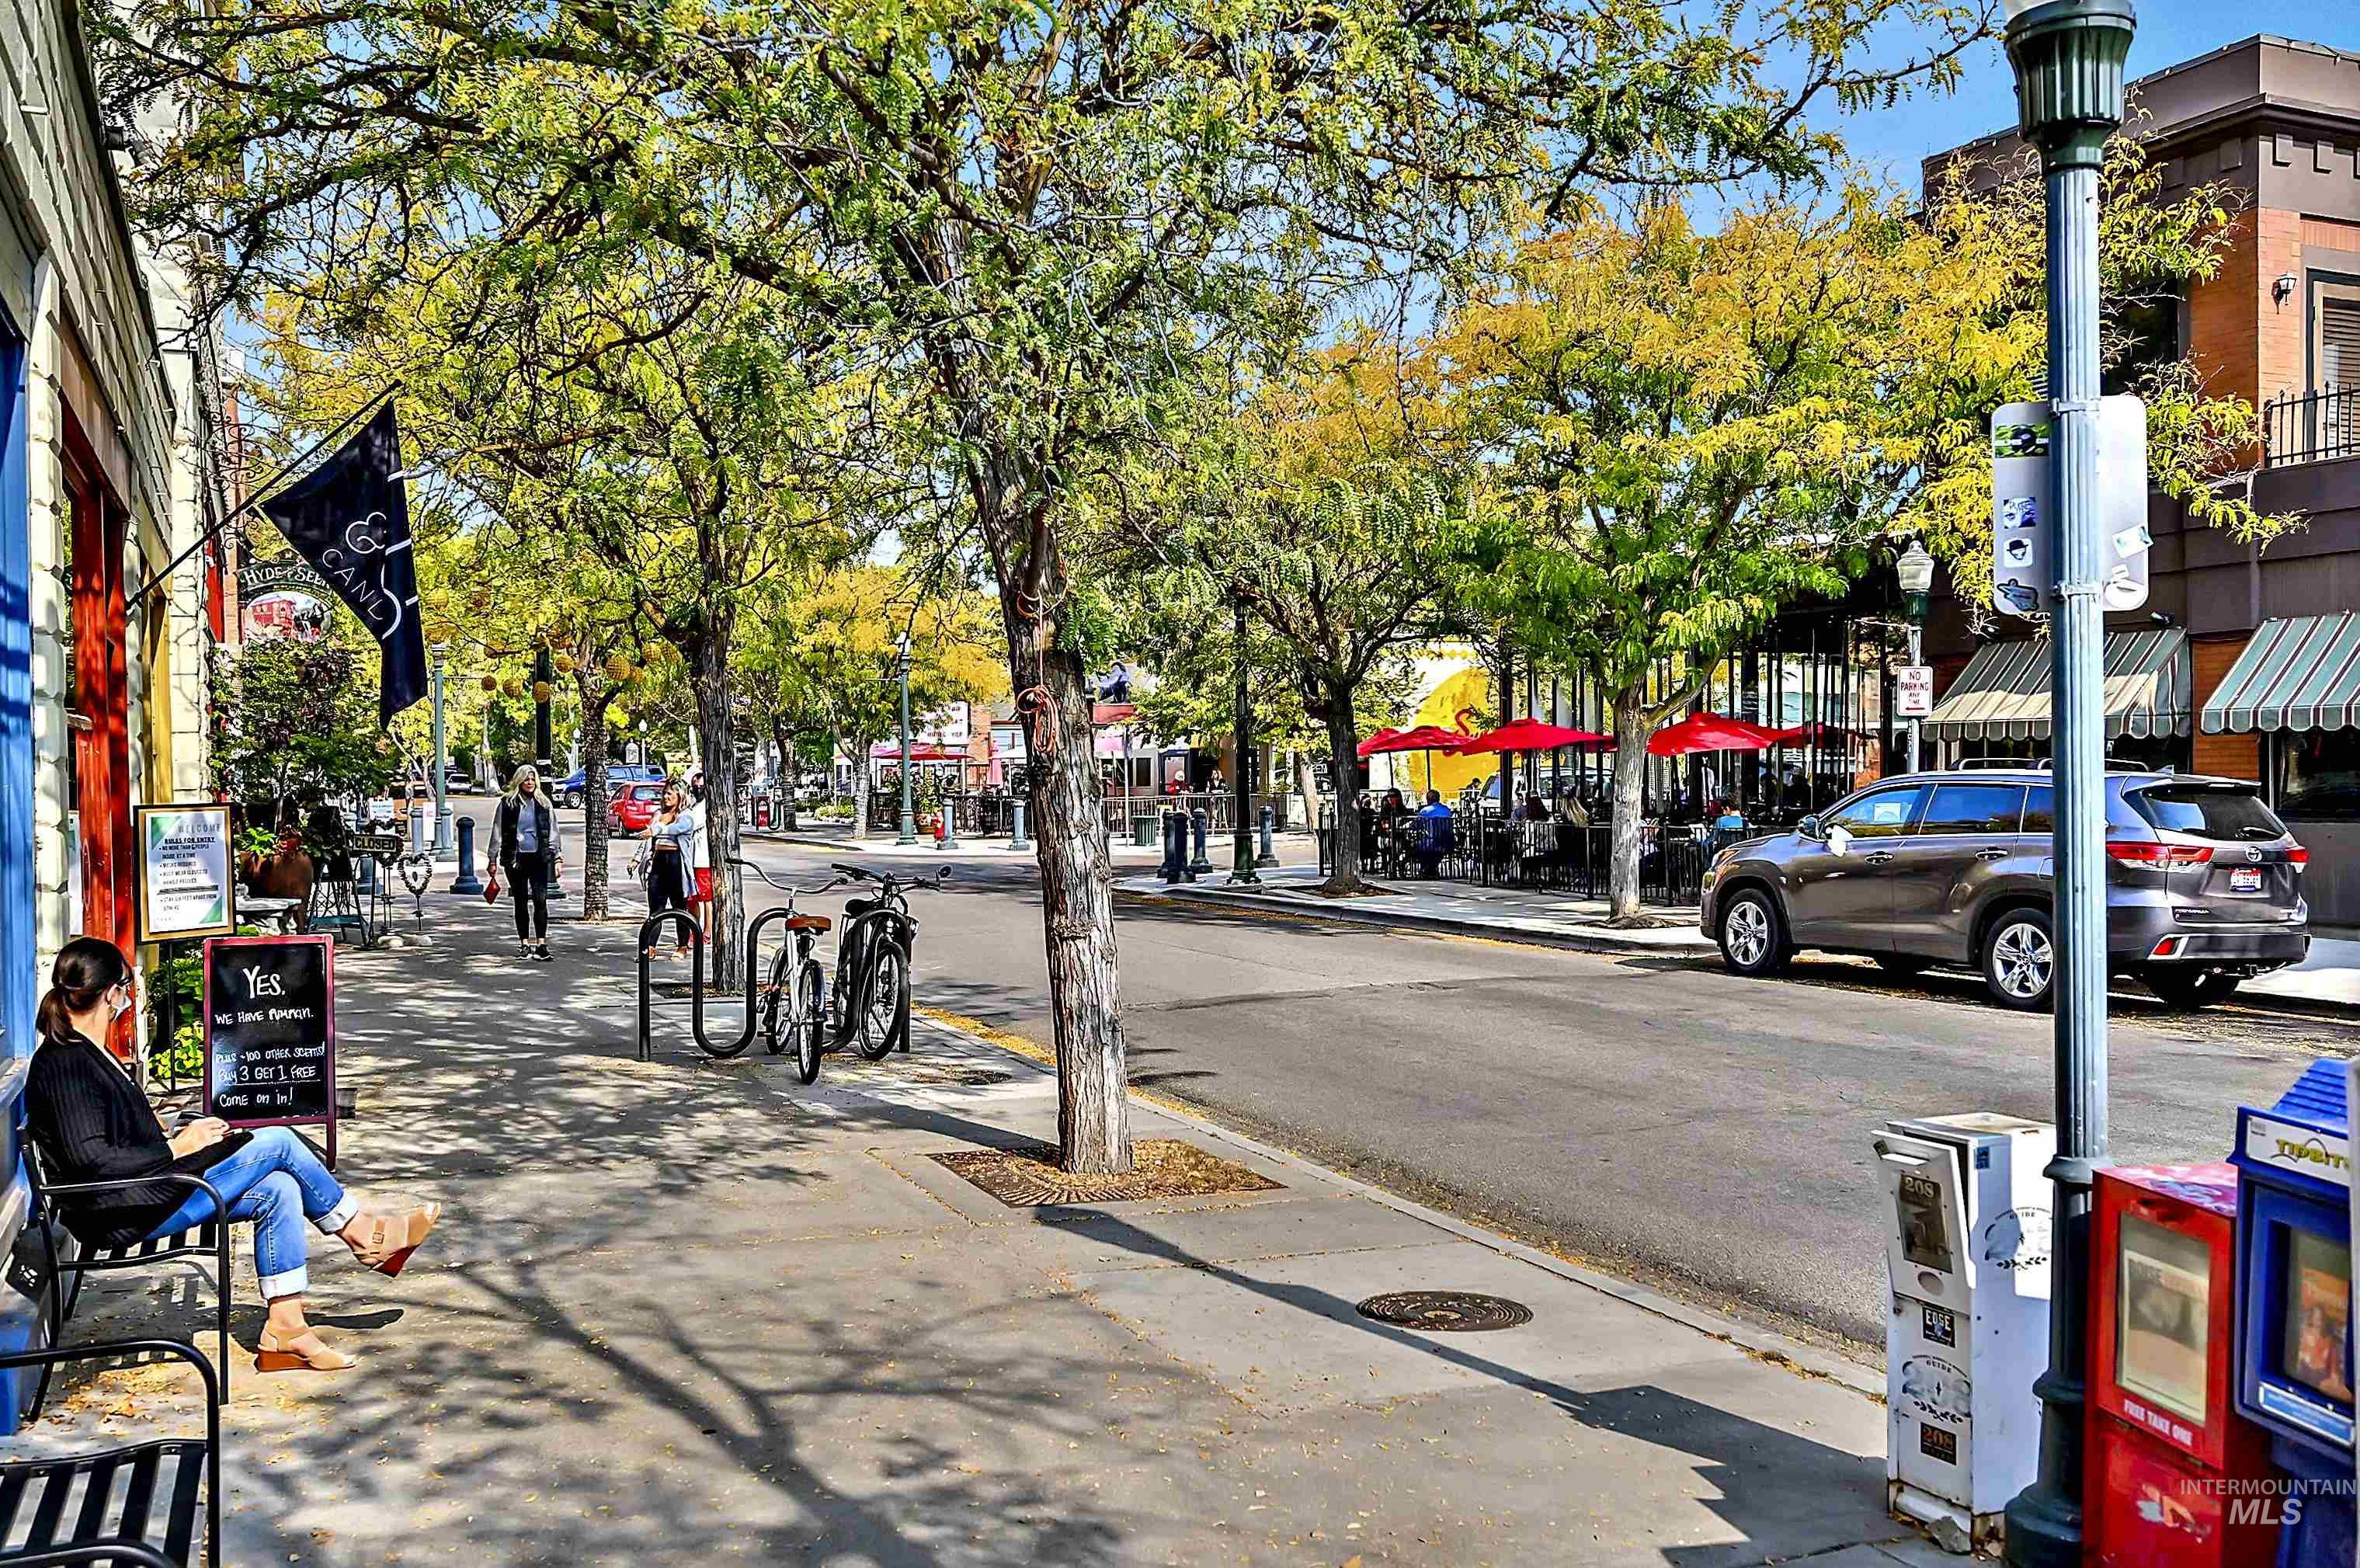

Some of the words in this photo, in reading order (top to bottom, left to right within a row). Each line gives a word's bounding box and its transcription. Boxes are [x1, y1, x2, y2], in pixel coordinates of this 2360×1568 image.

[244, 567, 283, 586] HYDE
[1909, 671, 1921, 680] NO
[1900, 682, 1929, 691] PARKING
[354, 838, 396, 850] CLOSED
[214, 1013, 234, 1025] WE
[237, 1011, 265, 1024] HAVE
[216, 1053, 237, 1064] PLUS
[265, 1048, 290, 1060] OTHER
[239, 1066, 249, 1081] 3
[255, 1066, 276, 1080] GET
[277, 1065, 287, 1080] 1
[290, 1064, 317, 1080] FREE
[1905, 1177, 1934, 1198] 208
[2172, 1424, 2193, 1446] ONE
